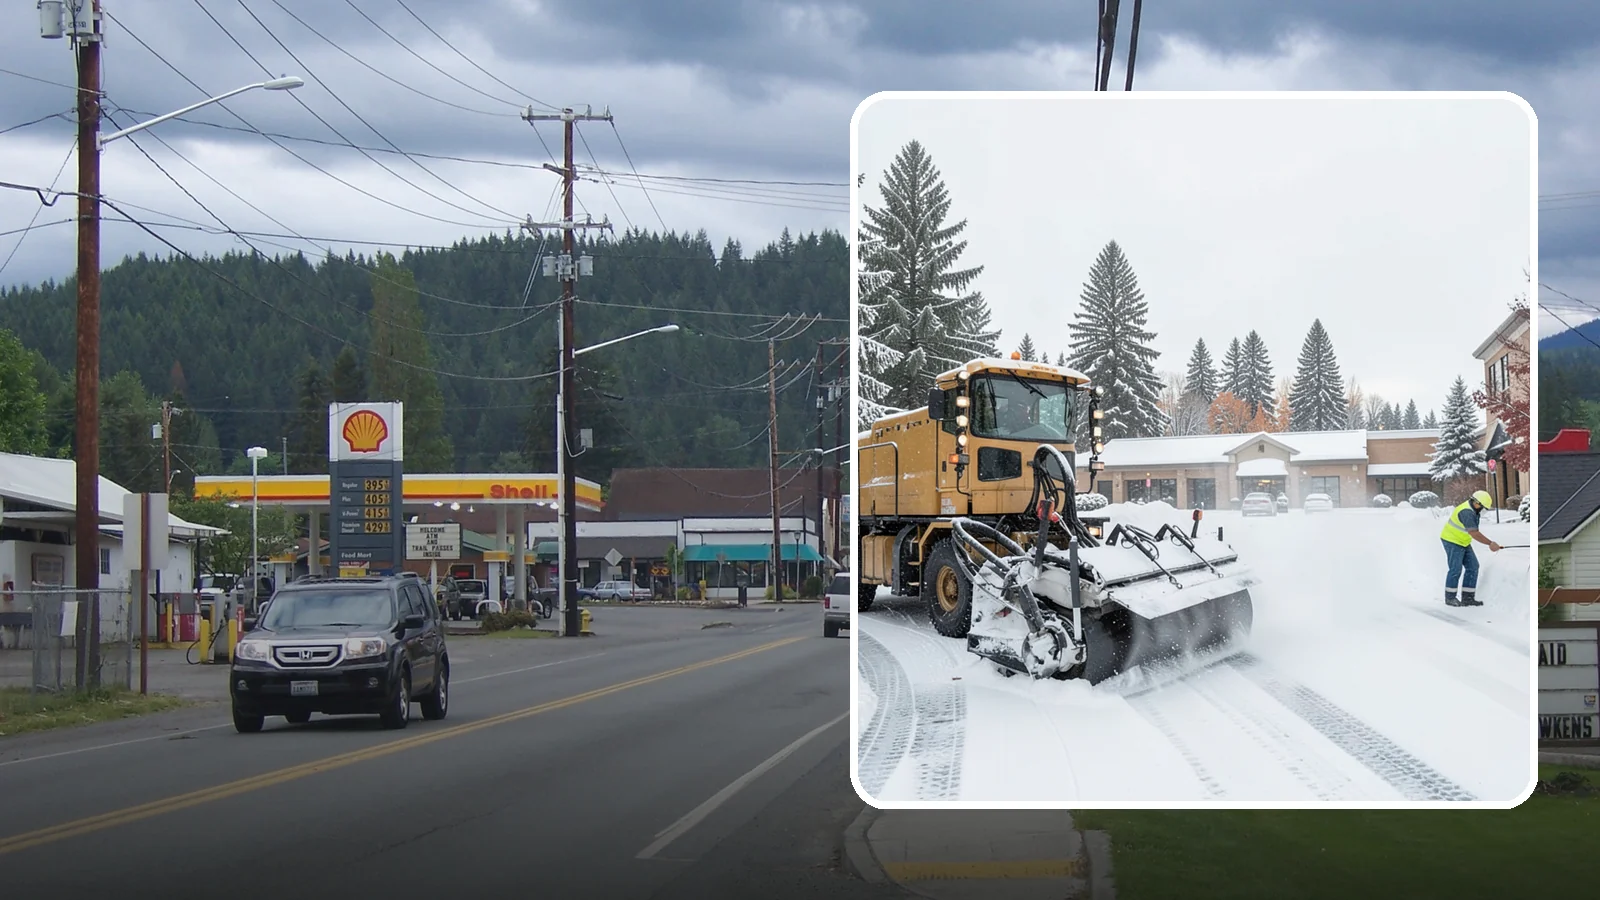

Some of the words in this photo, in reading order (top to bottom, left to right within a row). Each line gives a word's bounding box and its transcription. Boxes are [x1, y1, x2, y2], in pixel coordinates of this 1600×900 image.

[366, 480, 383, 490] 395
[490, 484, 547, 499] Shell
[366, 494, 383, 504] 405
[366, 508, 383, 518] 415
[366, 522, 383, 532] 429
